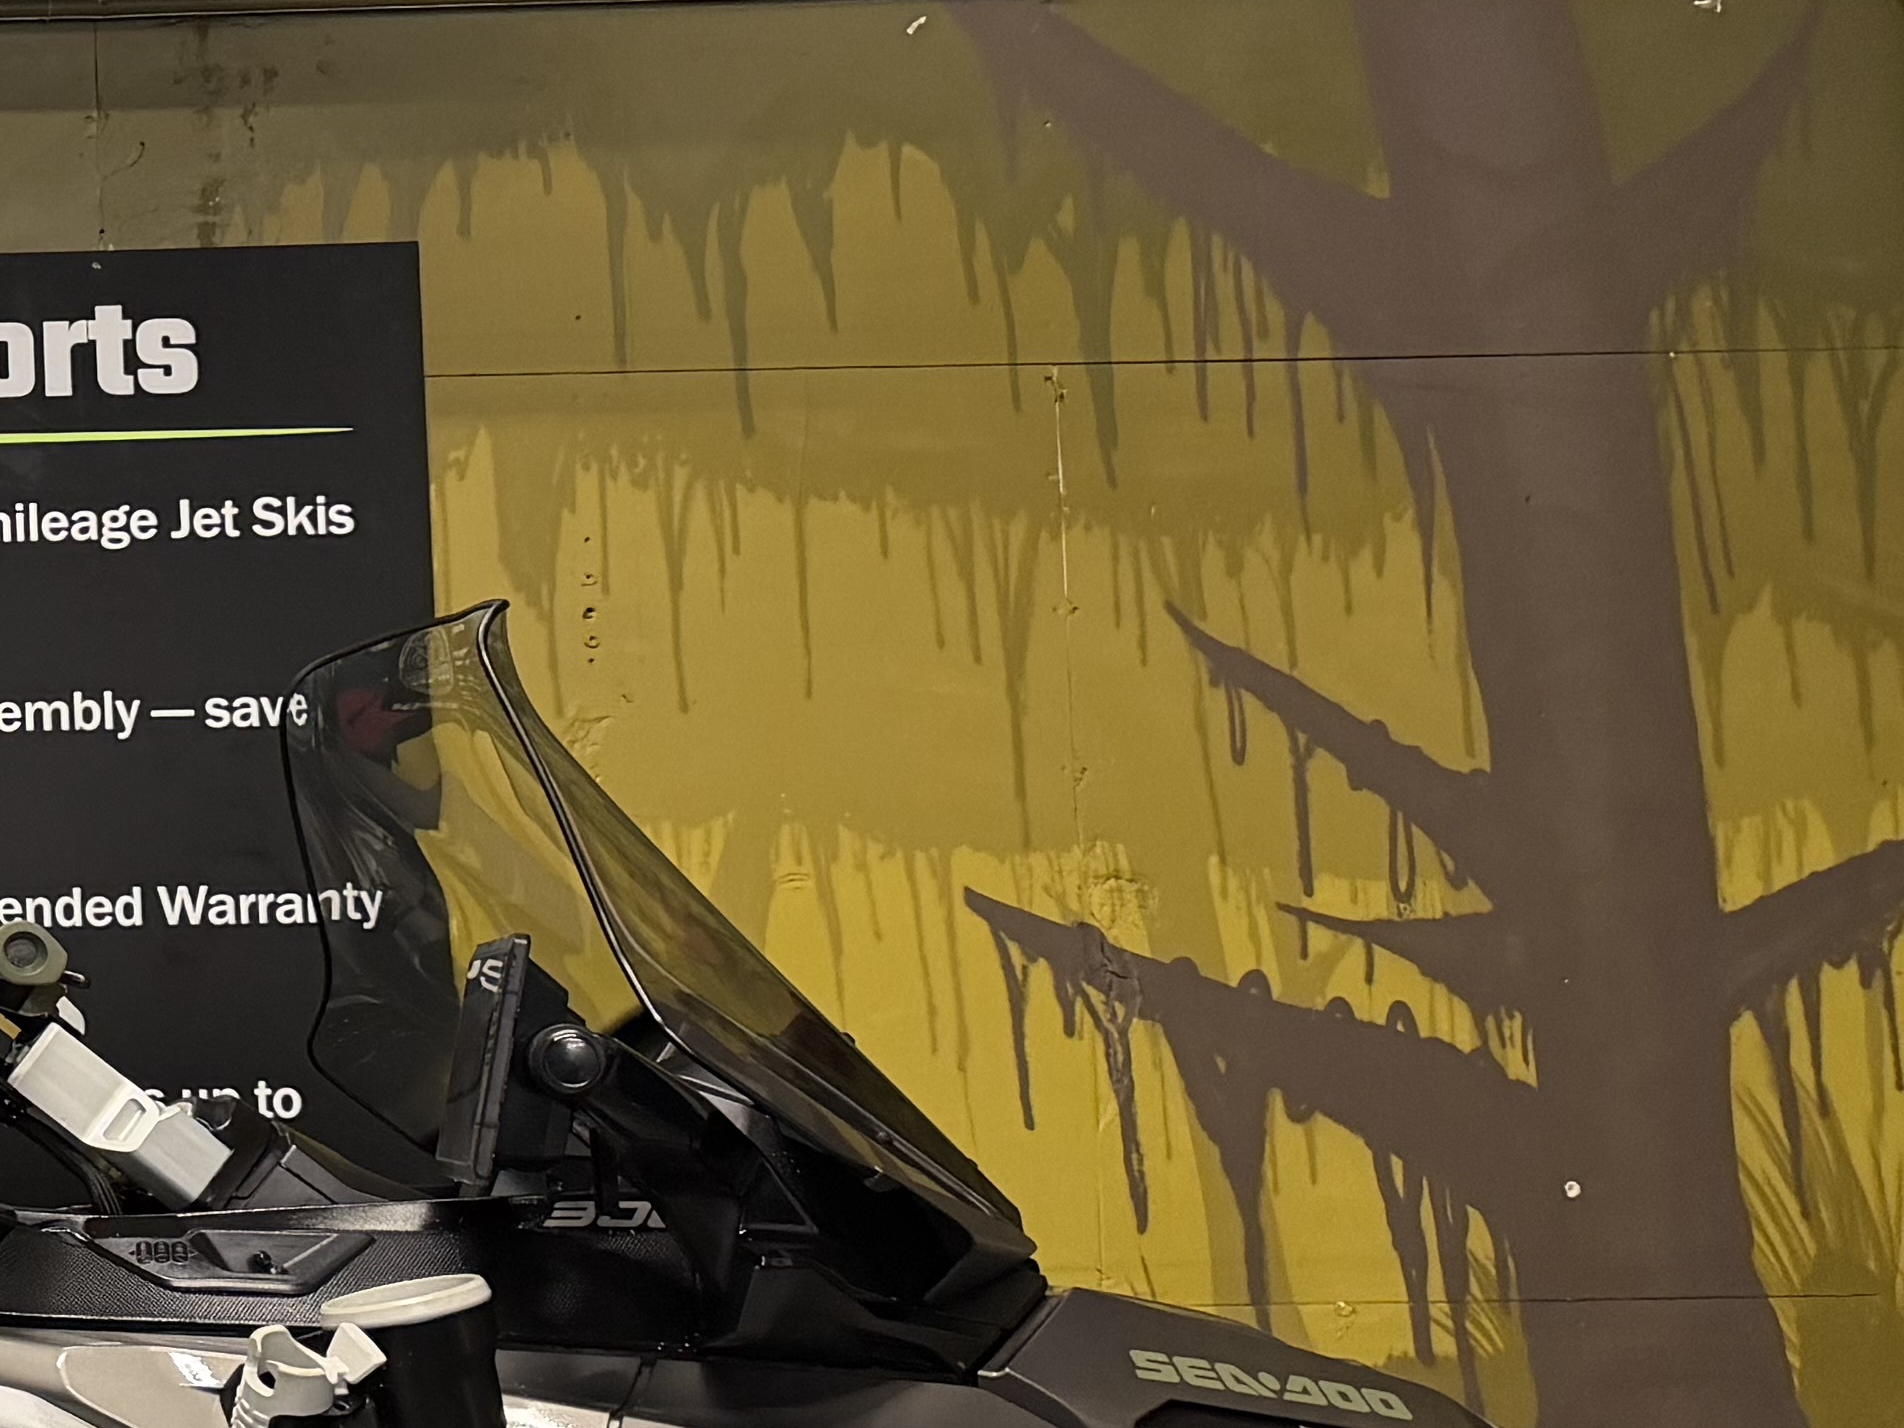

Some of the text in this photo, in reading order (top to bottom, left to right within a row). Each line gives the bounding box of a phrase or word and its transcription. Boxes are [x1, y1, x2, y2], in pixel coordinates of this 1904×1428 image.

[170, 498, 240, 540] Jet
[252, 495, 356, 537] Skis
[158, 882, 384, 930] Warranty
[254, 1080, 304, 1119] to
